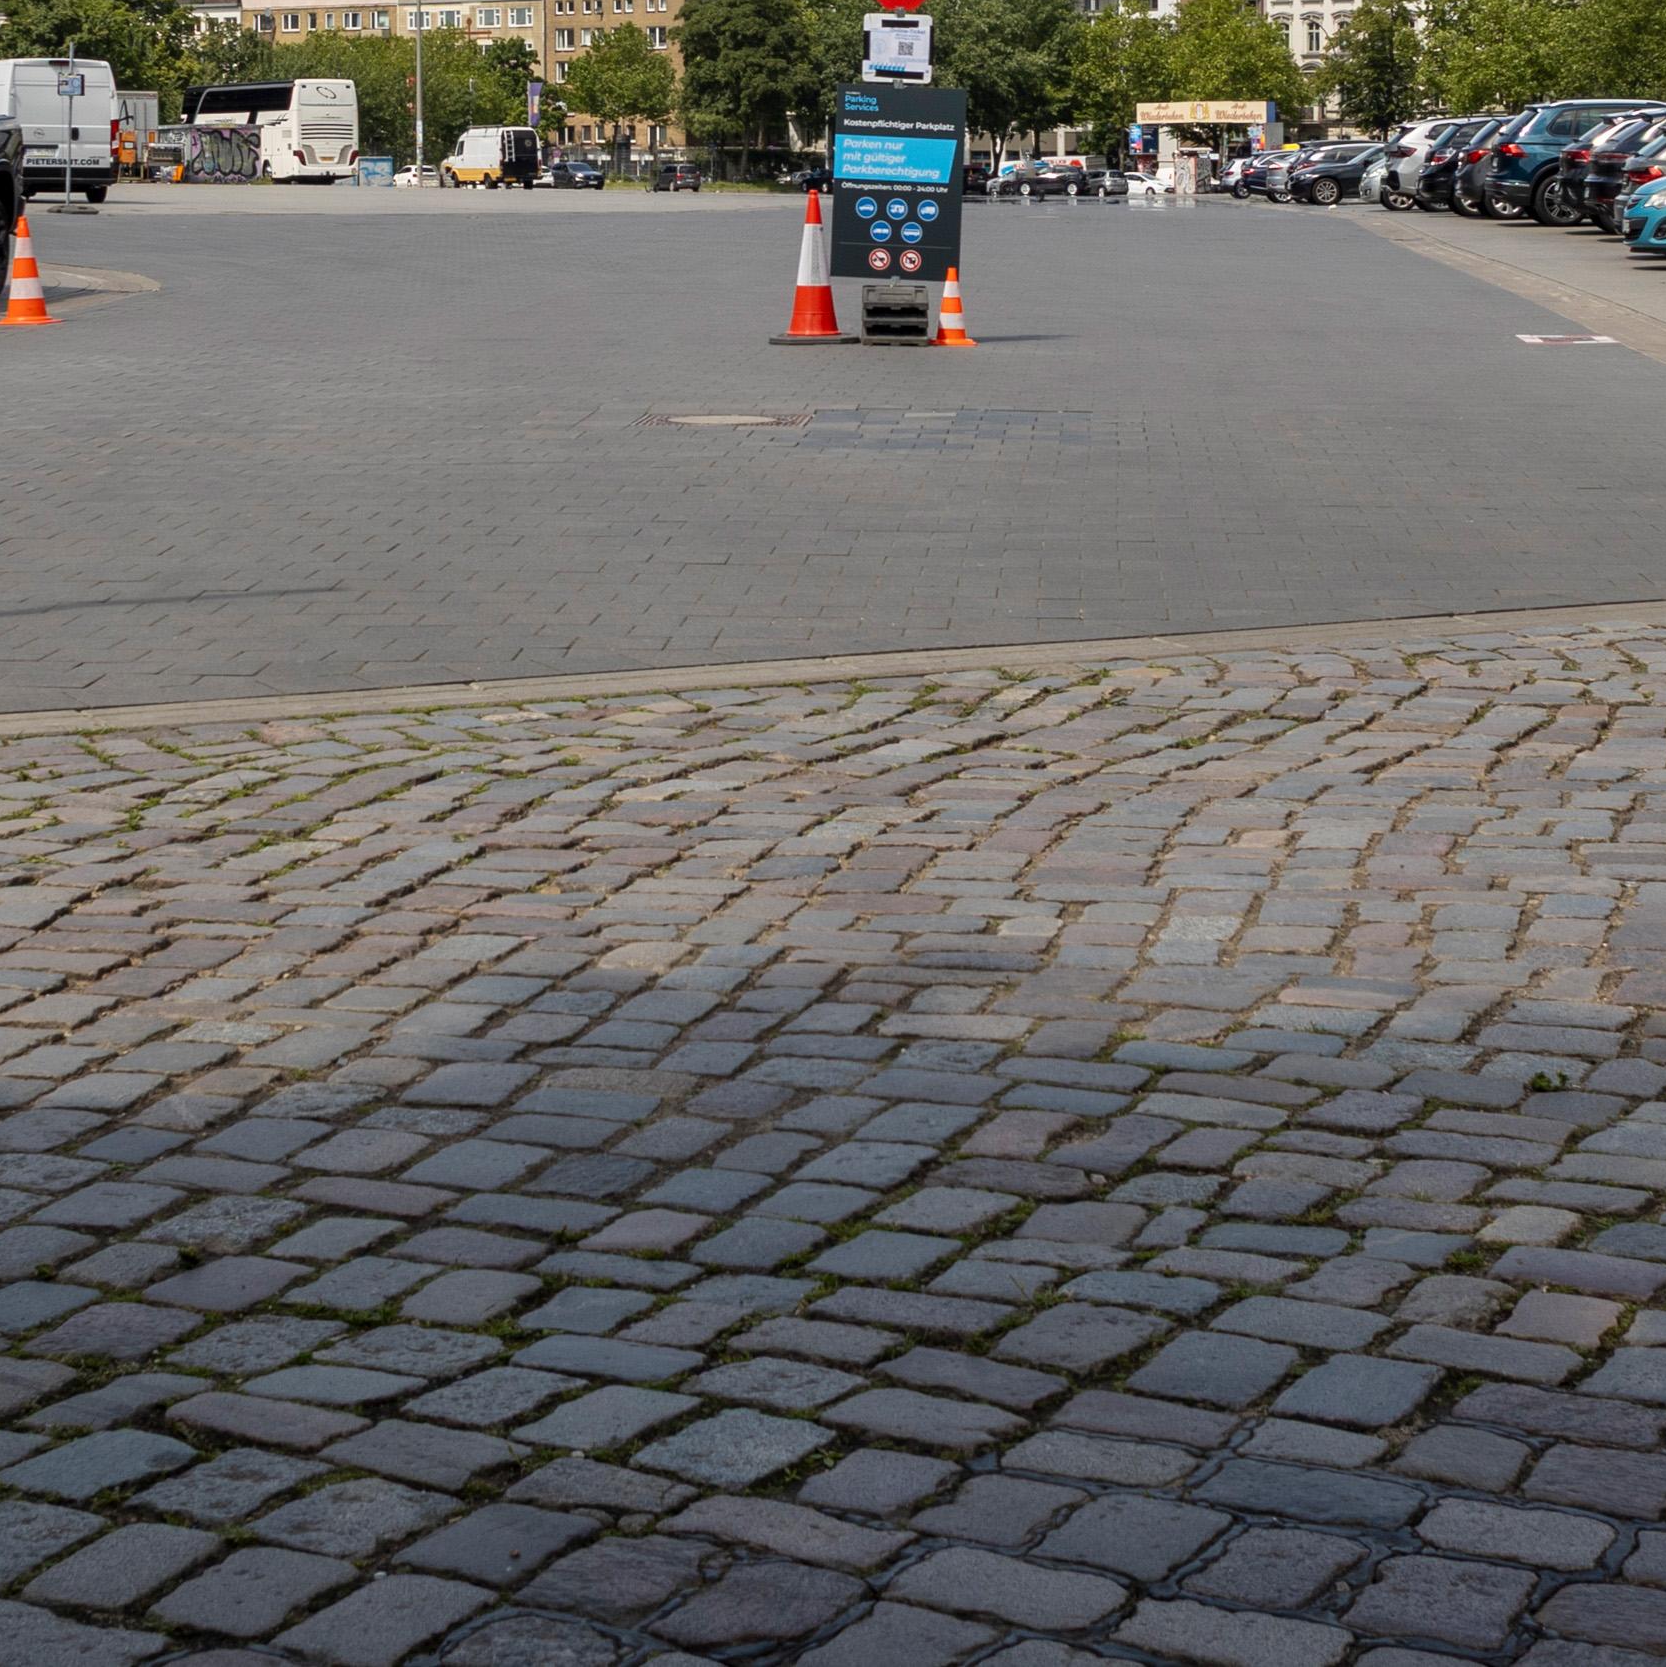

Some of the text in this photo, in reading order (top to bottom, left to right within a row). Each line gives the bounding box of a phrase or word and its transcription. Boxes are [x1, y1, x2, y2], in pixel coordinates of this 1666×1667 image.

[845, 95, 877, 104] Parking
[845, 103, 879, 111] Services
[844, 119, 955, 131] Kostenpflichtiger Parkplatz
[843, 138, 904, 150] Parken nur
[843, 152, 906, 164] mit gültiger
[842, 164, 940, 178] Parkberechtigung
[841, 182, 892, 191] Öffnungszeiten:
